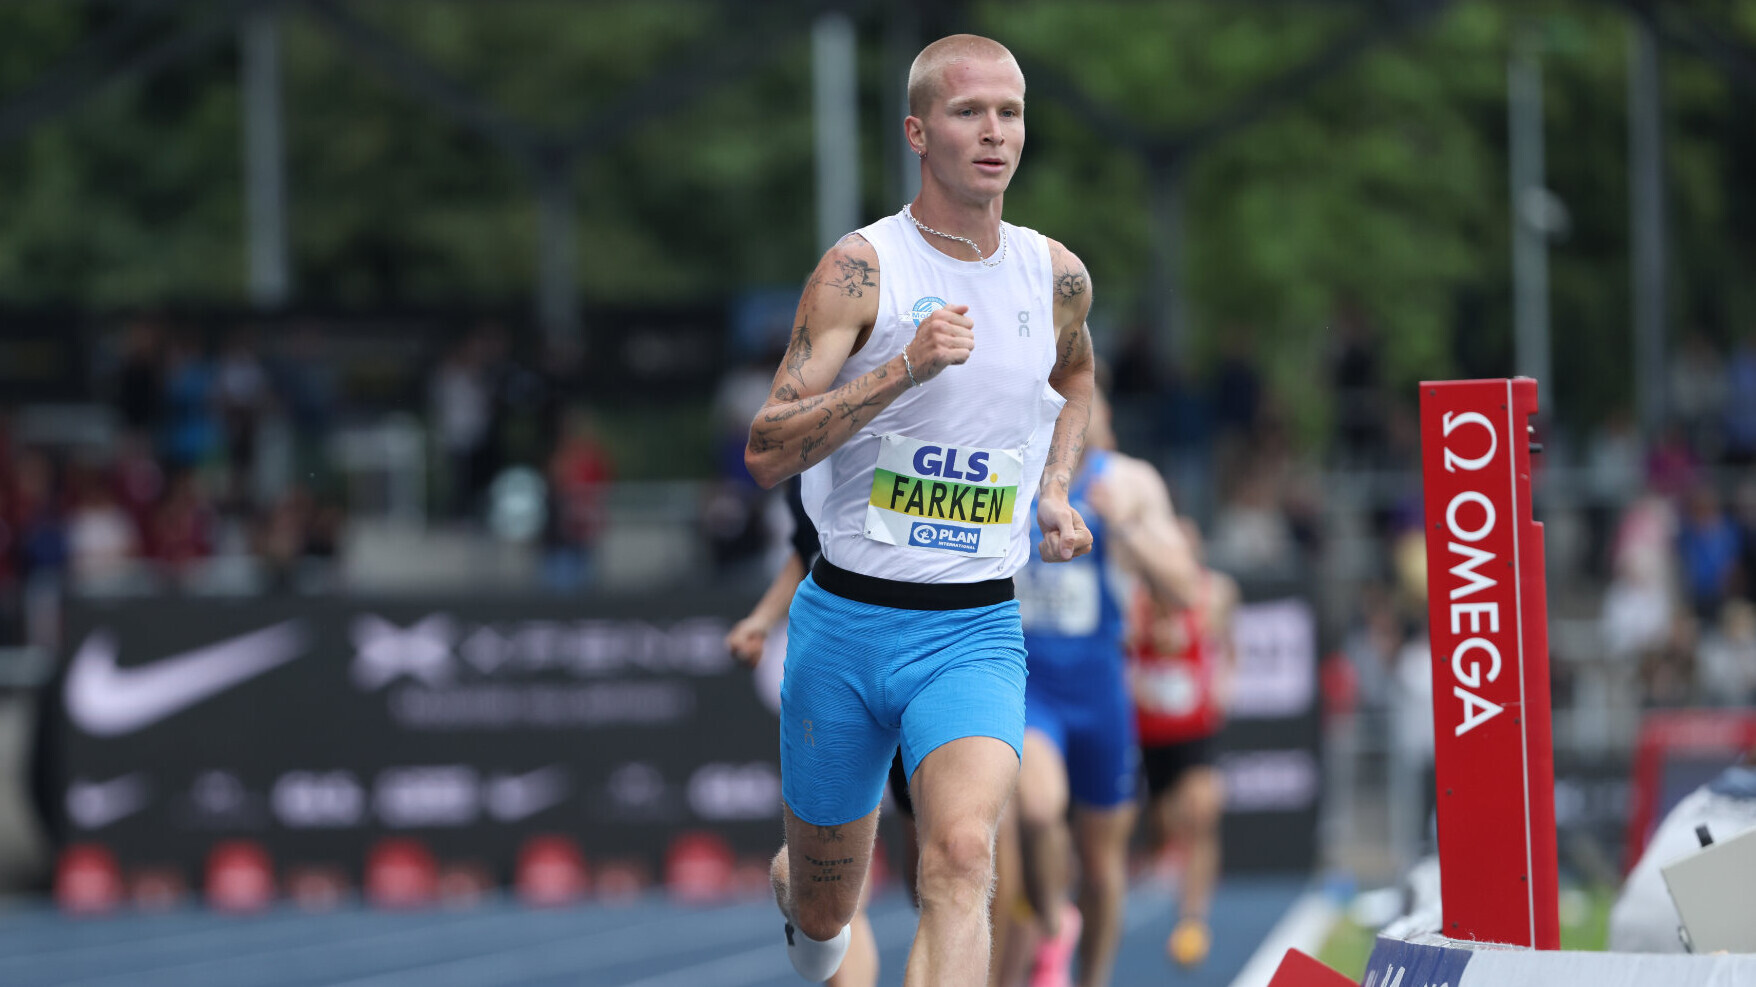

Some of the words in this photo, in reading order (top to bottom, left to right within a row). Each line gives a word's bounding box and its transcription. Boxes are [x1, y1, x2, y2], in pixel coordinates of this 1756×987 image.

[889, 474, 1005, 523] FARKEN
[938, 528, 978, 544] PLAN
[1446, 491, 1504, 737] OMEGA
